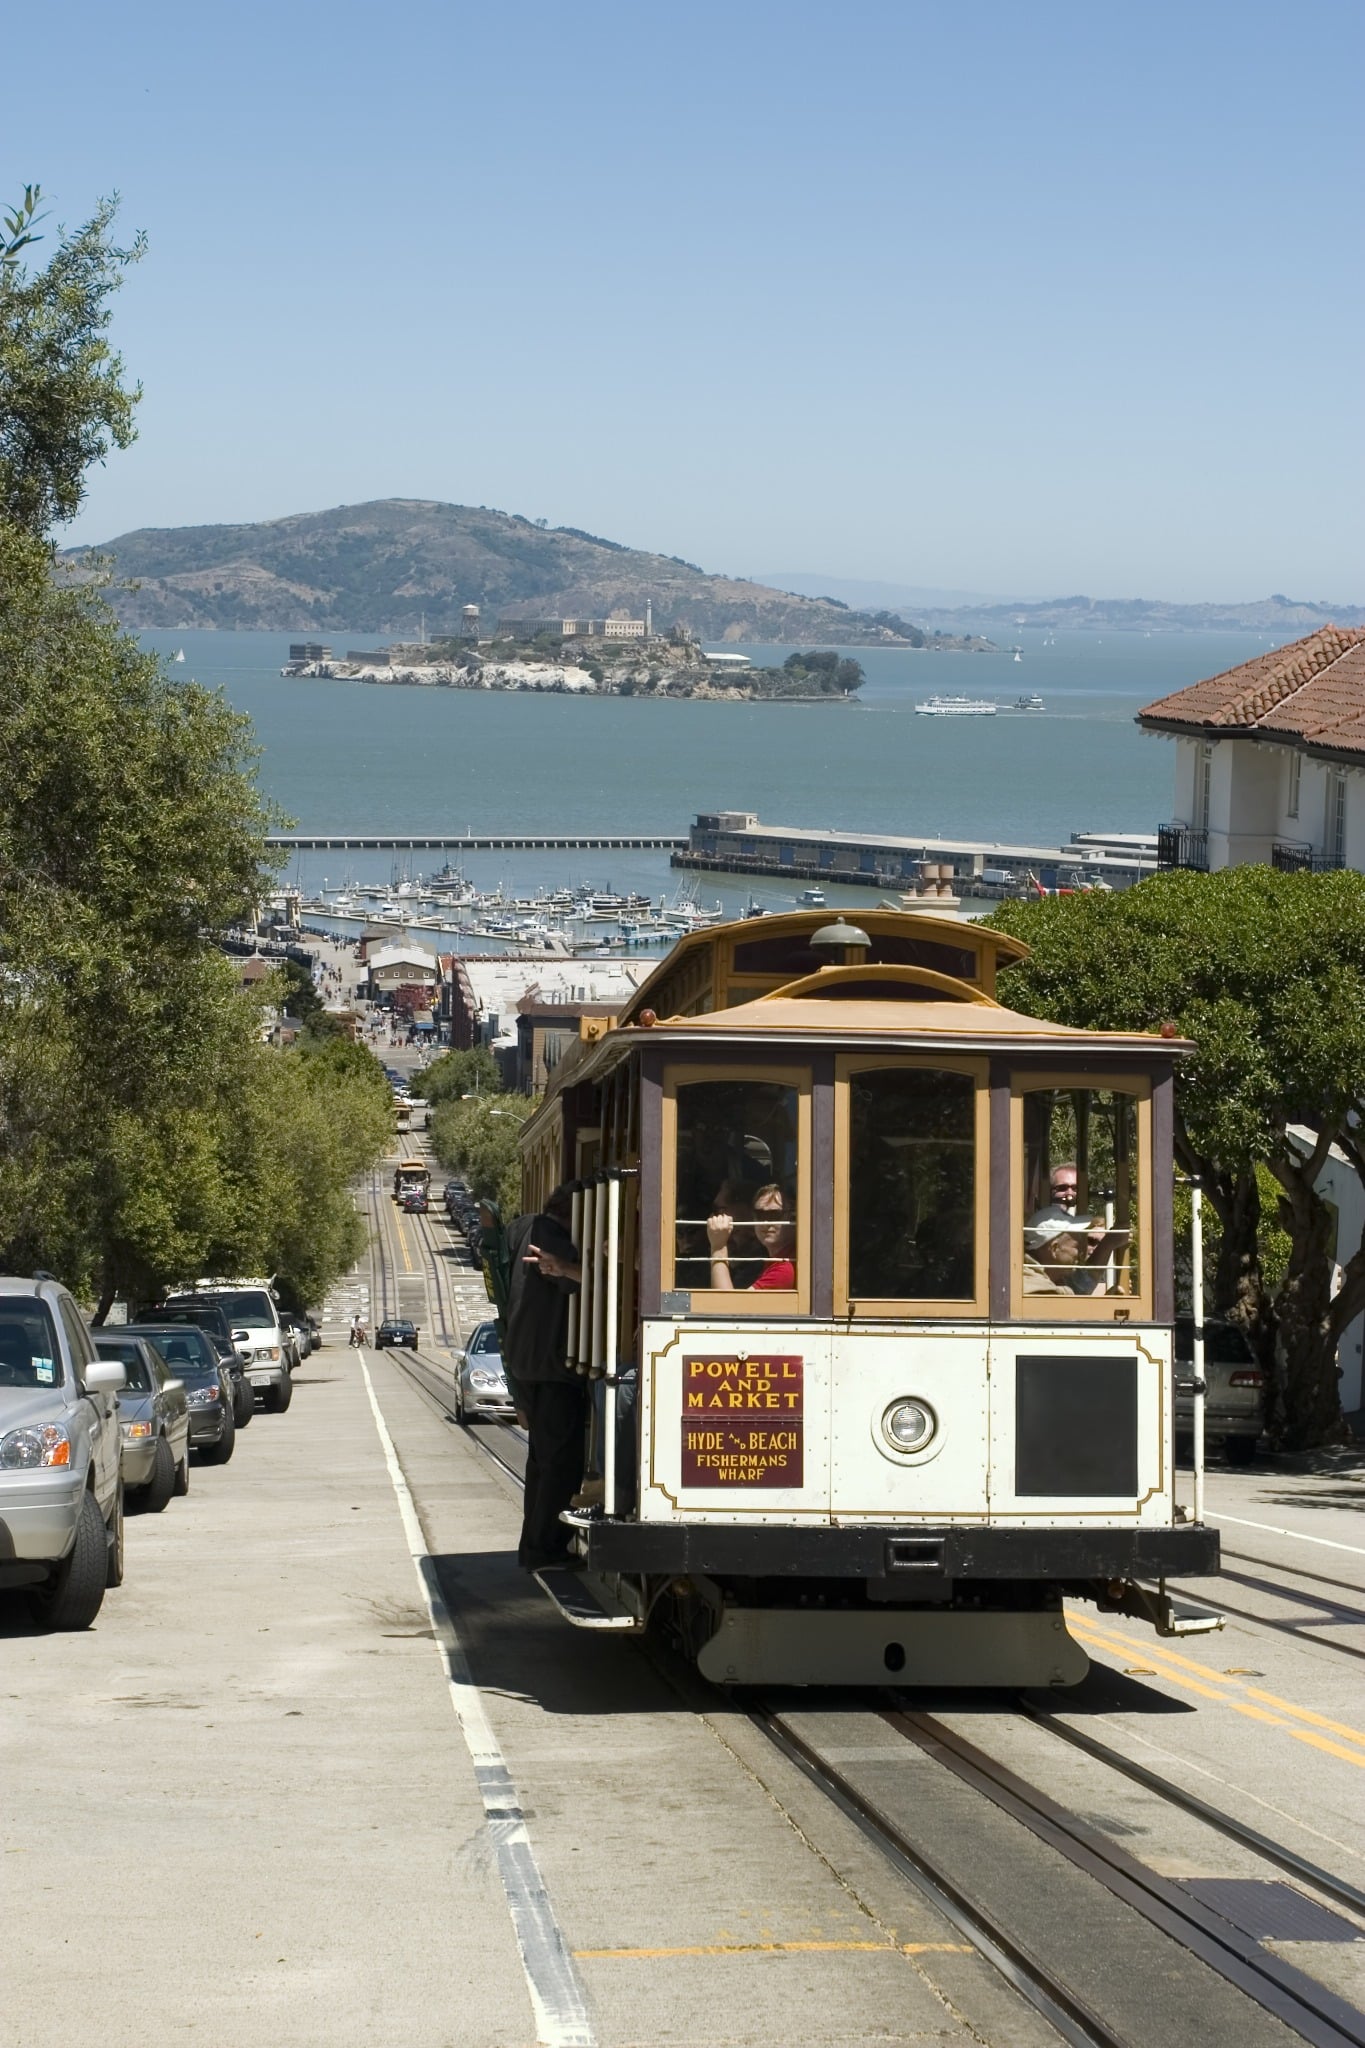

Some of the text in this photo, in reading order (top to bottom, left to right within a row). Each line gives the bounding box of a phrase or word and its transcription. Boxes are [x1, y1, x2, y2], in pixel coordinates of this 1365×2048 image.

[690, 1362, 797, 1378] POWELL
[718, 1380, 771, 1391] AND
[688, 1393, 799, 1408] MARKET
[688, 1432, 797, 1450] HYDE AND BEACH
[697, 1455, 787, 1467] FISHERMANS
[719, 1469, 765, 1480] WHARF
